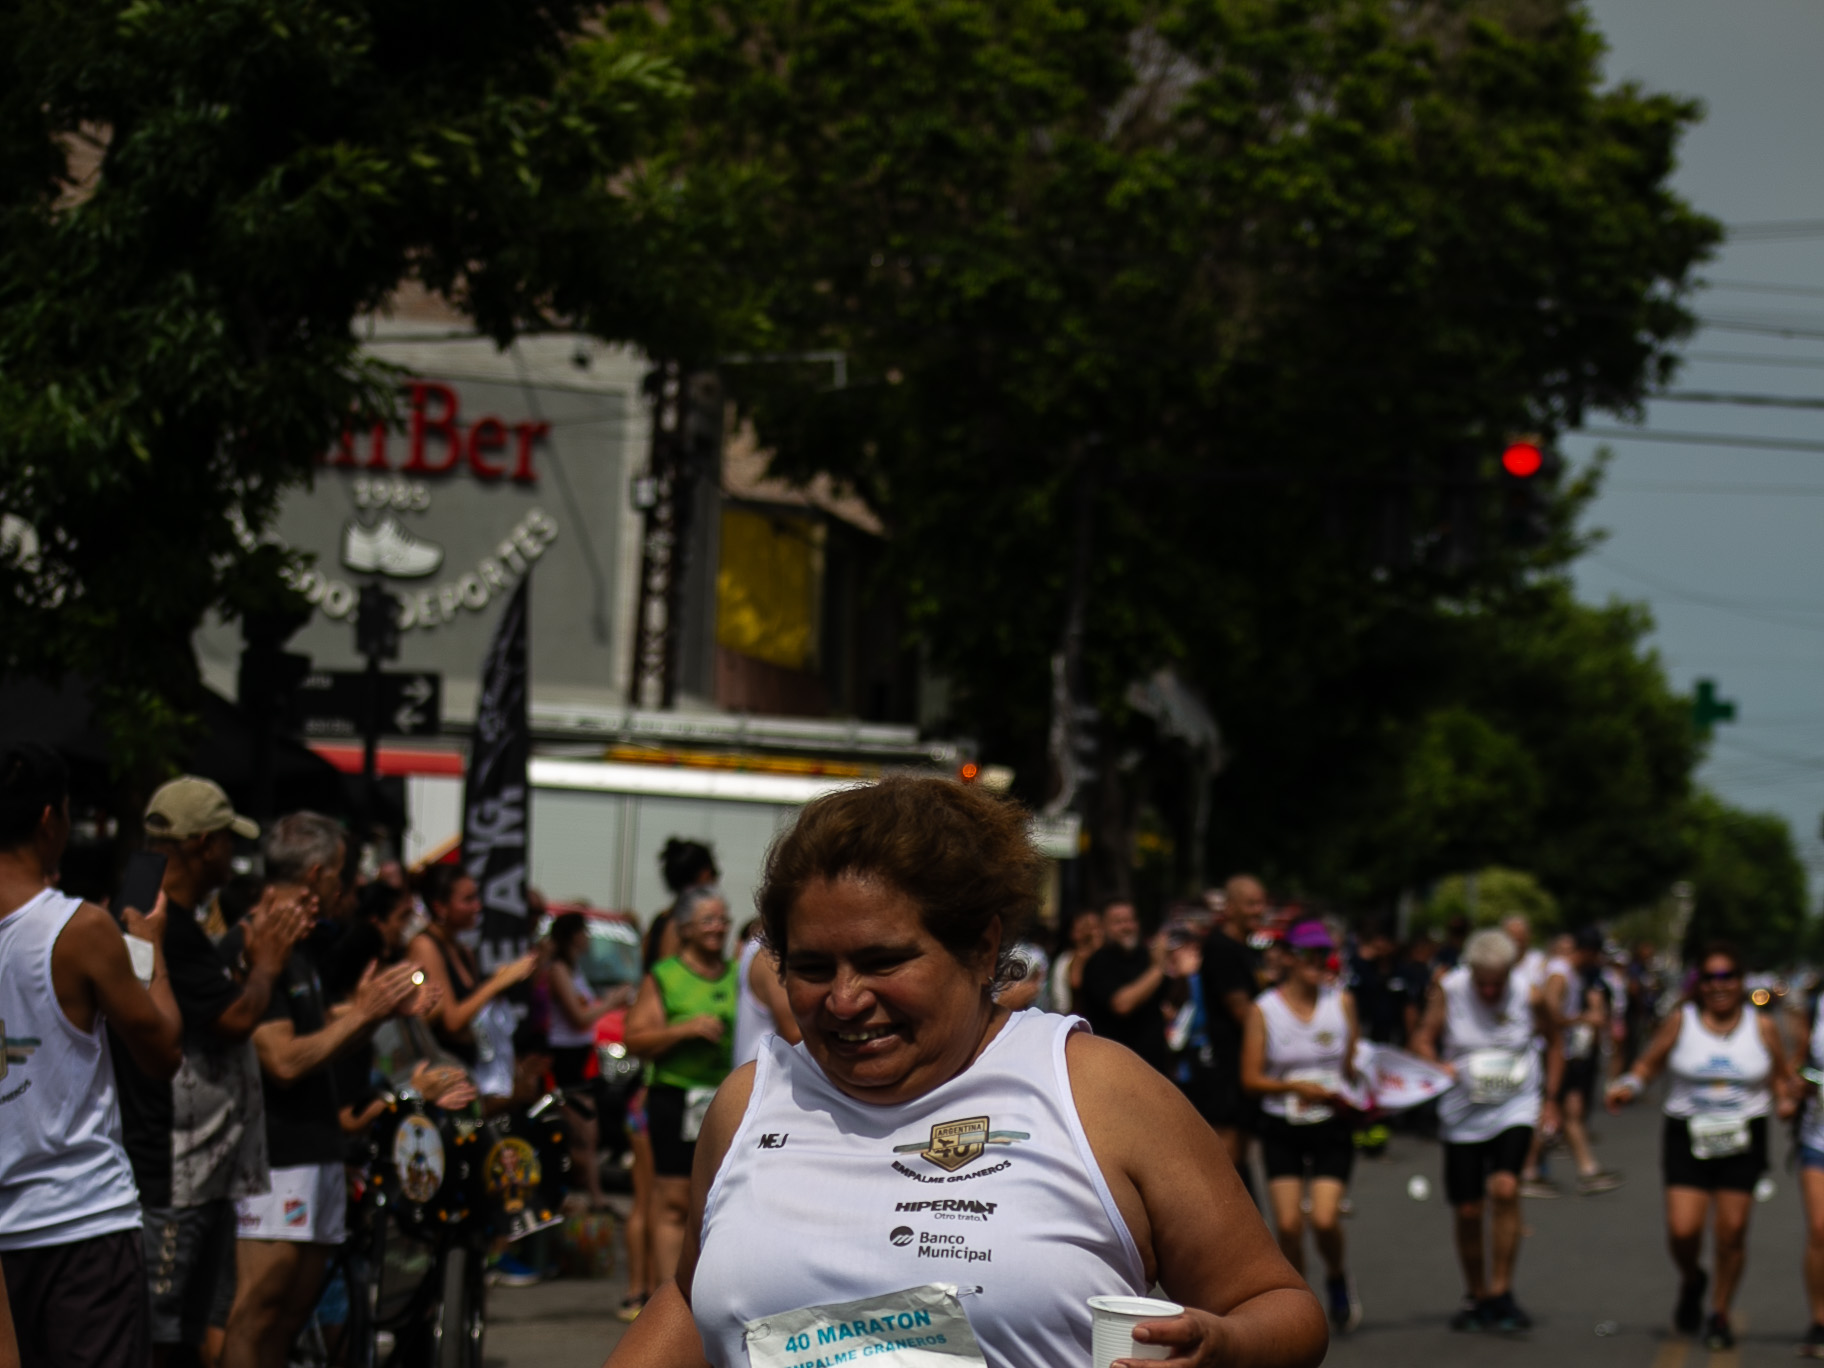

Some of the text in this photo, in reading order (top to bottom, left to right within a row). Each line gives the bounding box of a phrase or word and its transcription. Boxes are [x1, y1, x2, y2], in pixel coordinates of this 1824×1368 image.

[937, 1123, 982, 1136] ARGENTINA
[891, 1160, 1012, 1183] EMPALME GRANEROS
[934, 1212, 956, 1220] Otro
[920, 1231, 965, 1244] Banco
[917, 1245, 992, 1263] Municipal
[785, 1309, 932, 1353] 40 MARATON
[863, 1333, 948, 1357] GRANEROS
